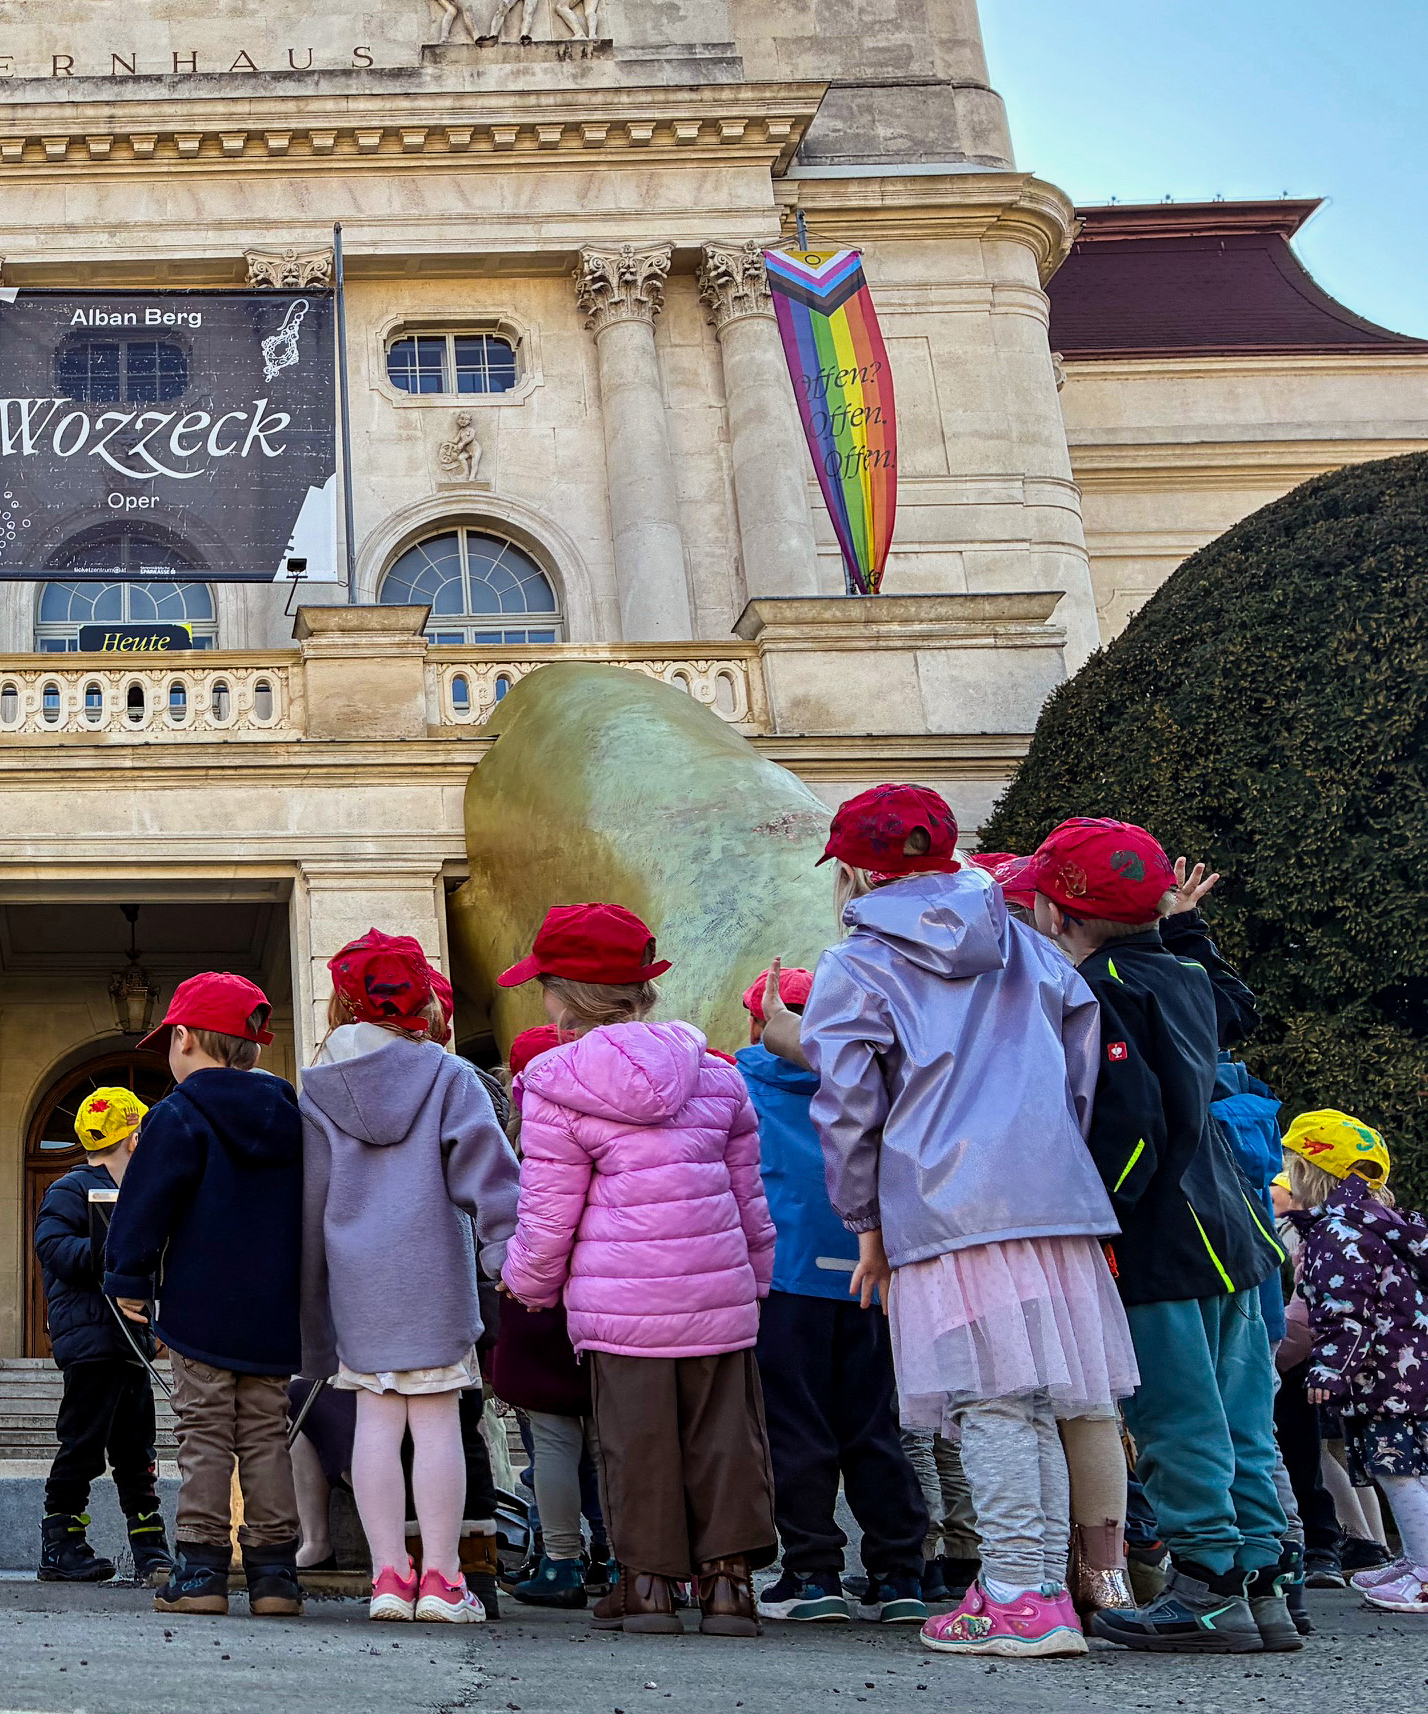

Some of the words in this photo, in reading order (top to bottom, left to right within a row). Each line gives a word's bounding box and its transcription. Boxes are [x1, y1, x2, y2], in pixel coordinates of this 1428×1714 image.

[70, 308, 138, 327] Alban
[145, 308, 203, 329] Berg
[794, 361, 883, 402] Offen?
[808, 403, 888, 440] Offen.
[107, 491, 161, 511] Oper
[100, 631, 171, 652] Heute
